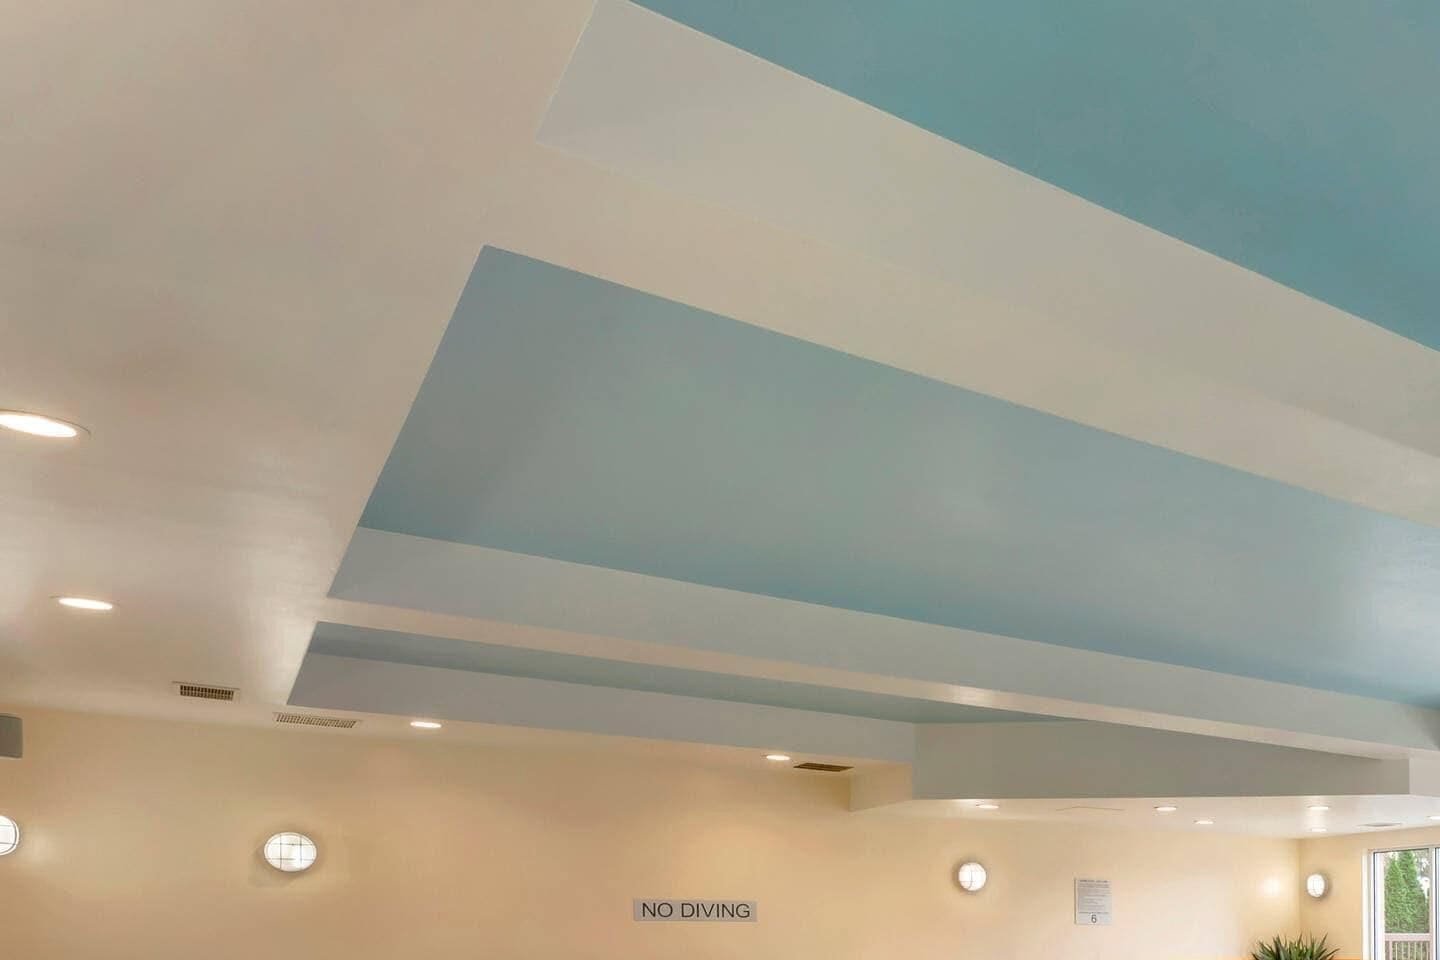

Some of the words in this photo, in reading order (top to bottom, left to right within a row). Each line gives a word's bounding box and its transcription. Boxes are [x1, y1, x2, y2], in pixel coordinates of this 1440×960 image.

[642, 902, 673, 918] NO
[681, 902, 750, 918] DIVING
[1091, 914, 1097, 923] 6
